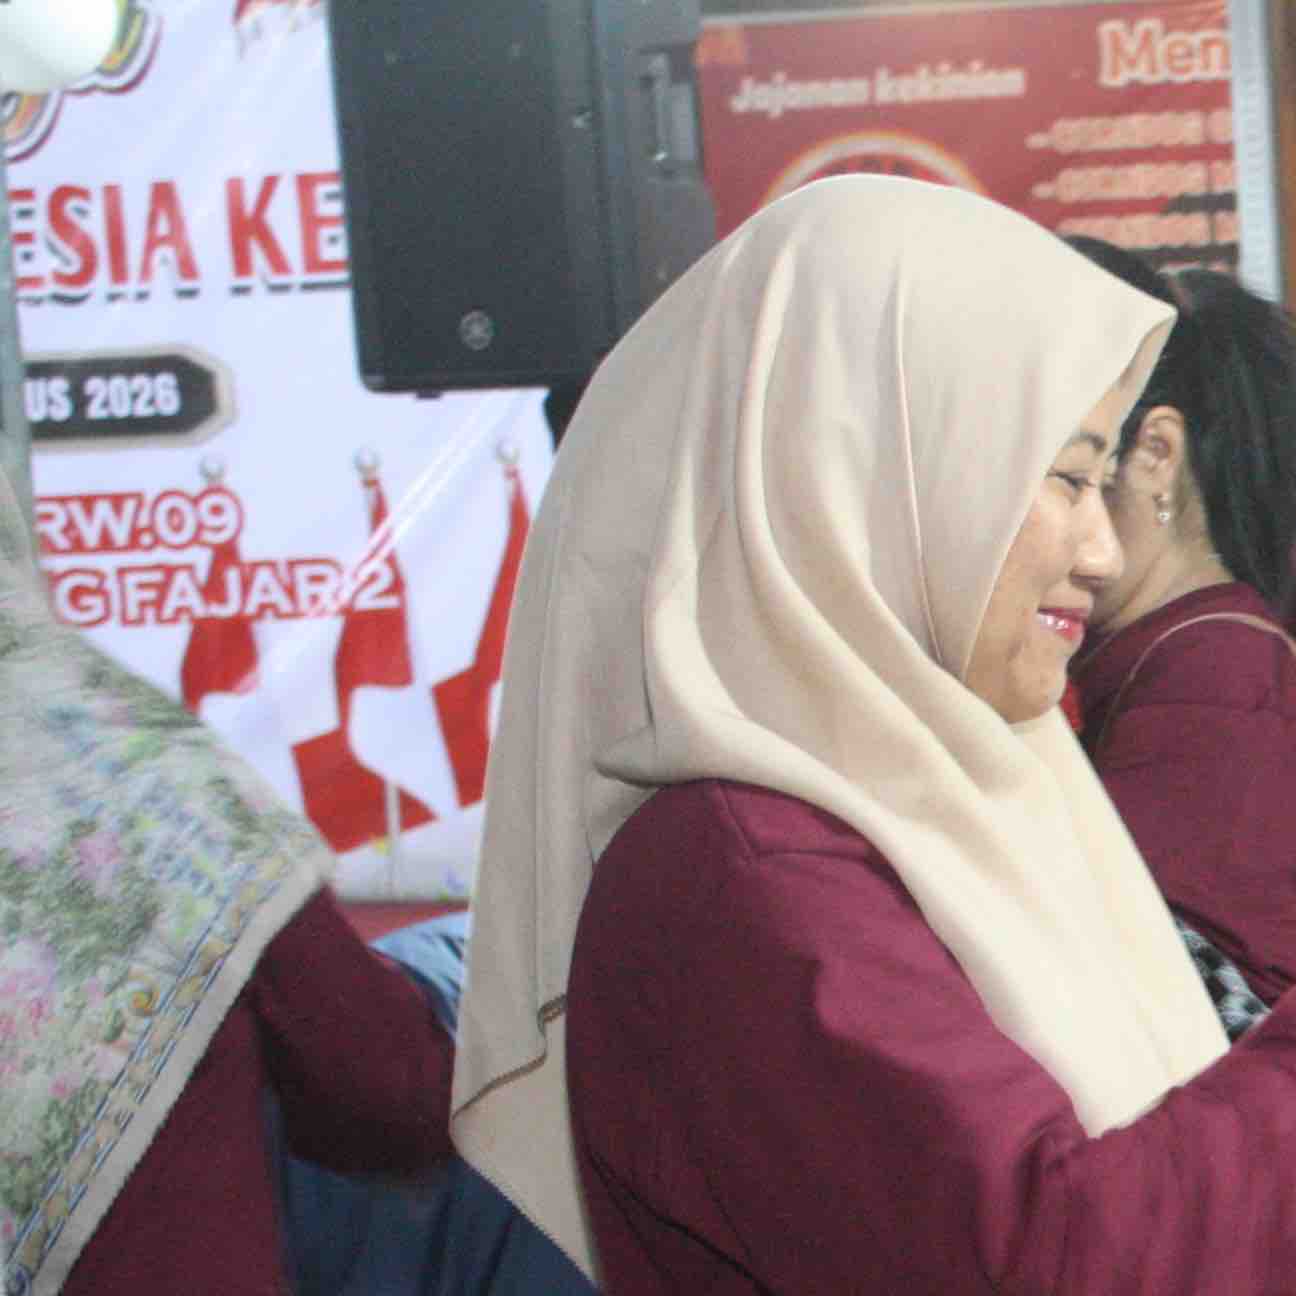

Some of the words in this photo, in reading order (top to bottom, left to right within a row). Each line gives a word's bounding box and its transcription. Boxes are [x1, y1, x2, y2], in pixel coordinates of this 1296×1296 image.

[84, 372, 182, 419] 2026
[121, 559, 347, 625] FAJAR
[352, 560, 401, 611] 2
